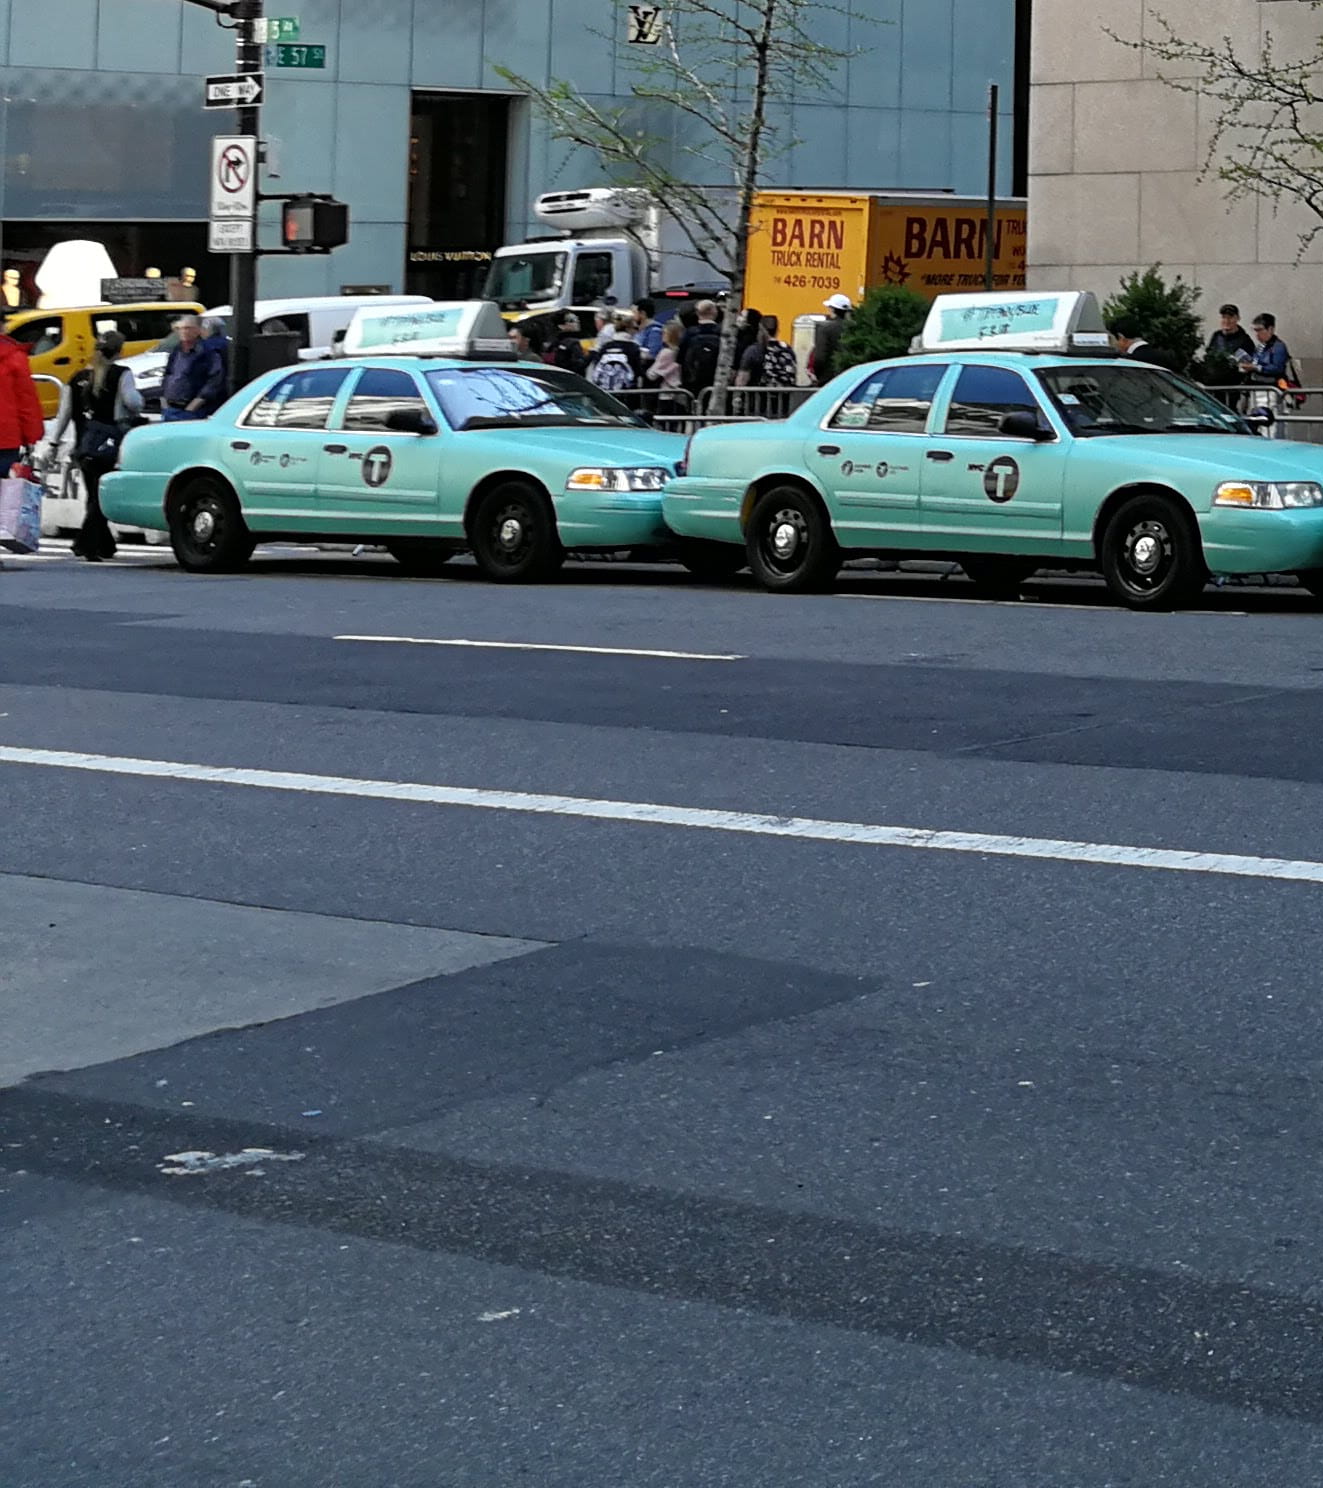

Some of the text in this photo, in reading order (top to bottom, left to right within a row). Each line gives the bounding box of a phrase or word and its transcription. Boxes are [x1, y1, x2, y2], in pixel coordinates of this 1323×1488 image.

[771, 217, 845, 250] BARN
[904, 216, 1003, 261] BARN
[771, 250, 841, 269] TRUCK RENTAL
[992, 465, 1014, 498] T
